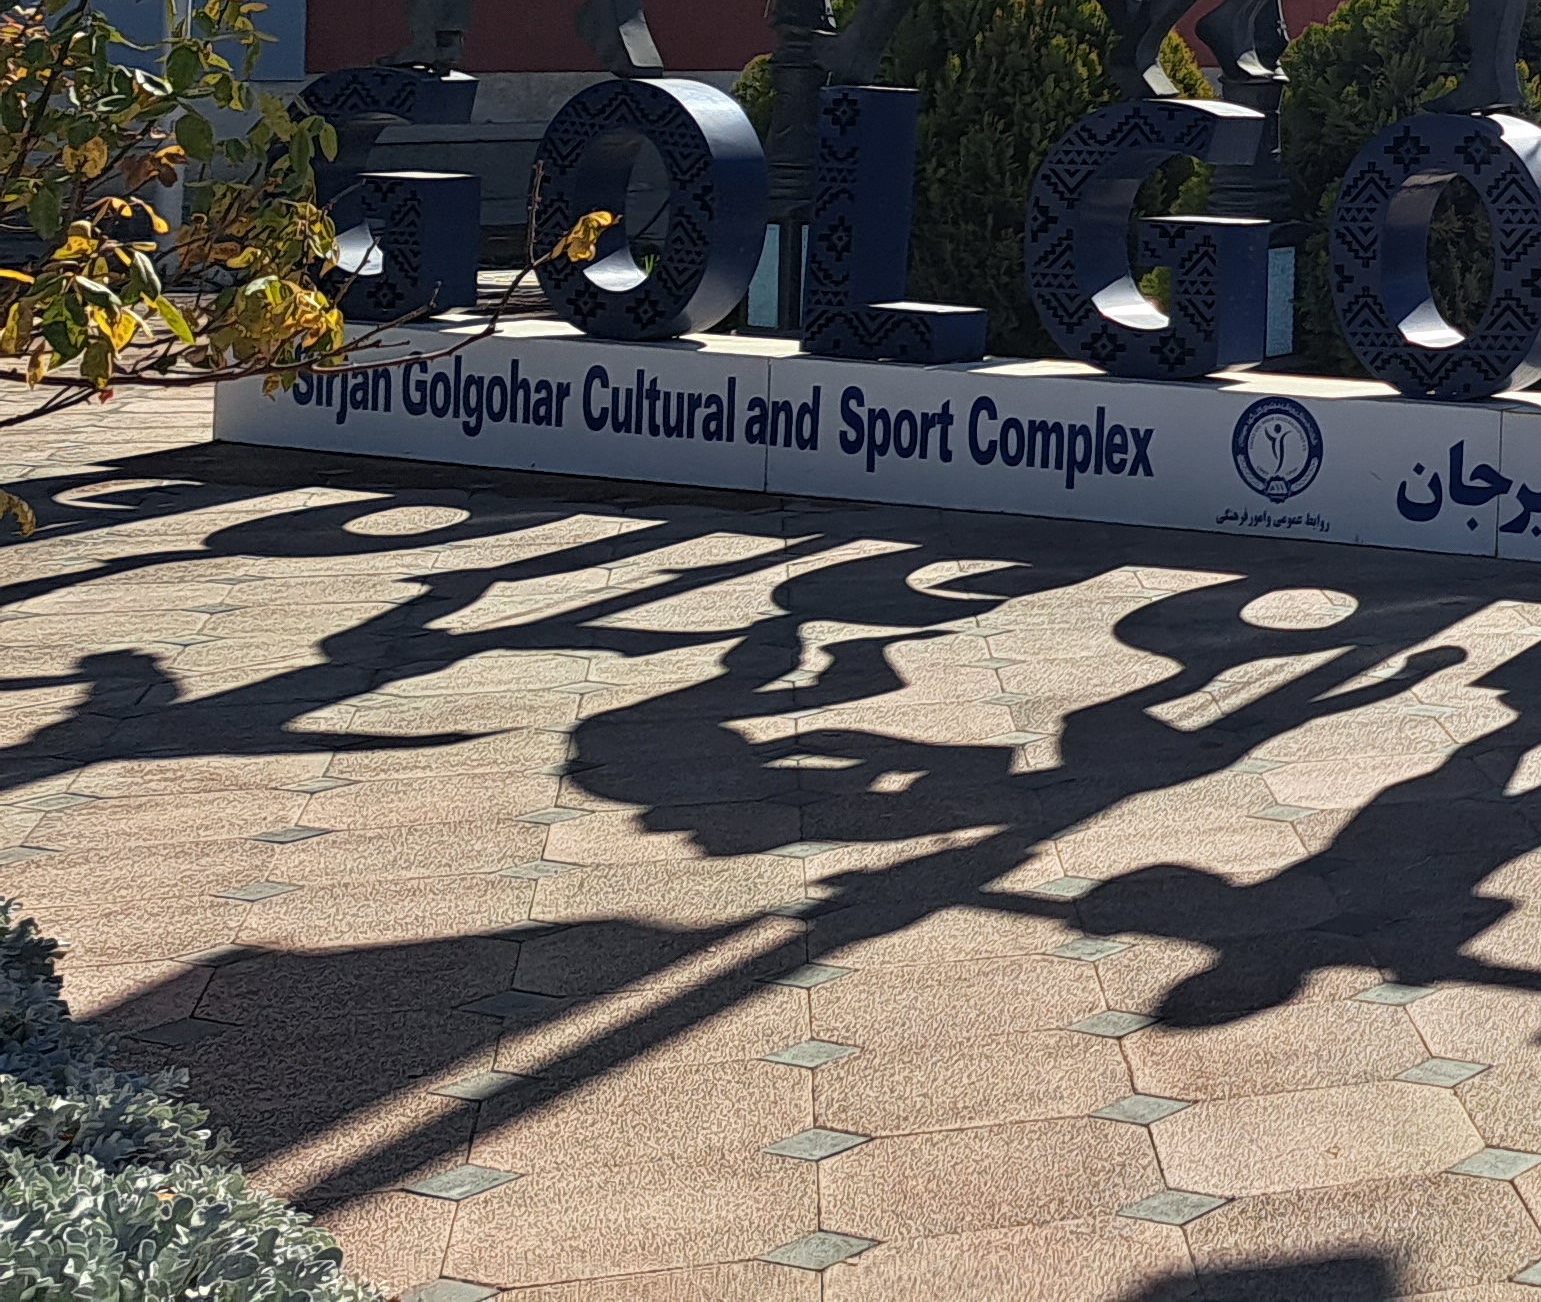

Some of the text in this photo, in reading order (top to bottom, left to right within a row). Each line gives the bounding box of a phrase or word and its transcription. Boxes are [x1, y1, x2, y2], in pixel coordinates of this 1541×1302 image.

[402, 351, 571, 437] Golgohar
[582, 364, 737, 443] Cultural
[744, 385, 822, 451] and
[839, 385, 955, 473] Sport
[968, 395, 1156, 490] Complex
